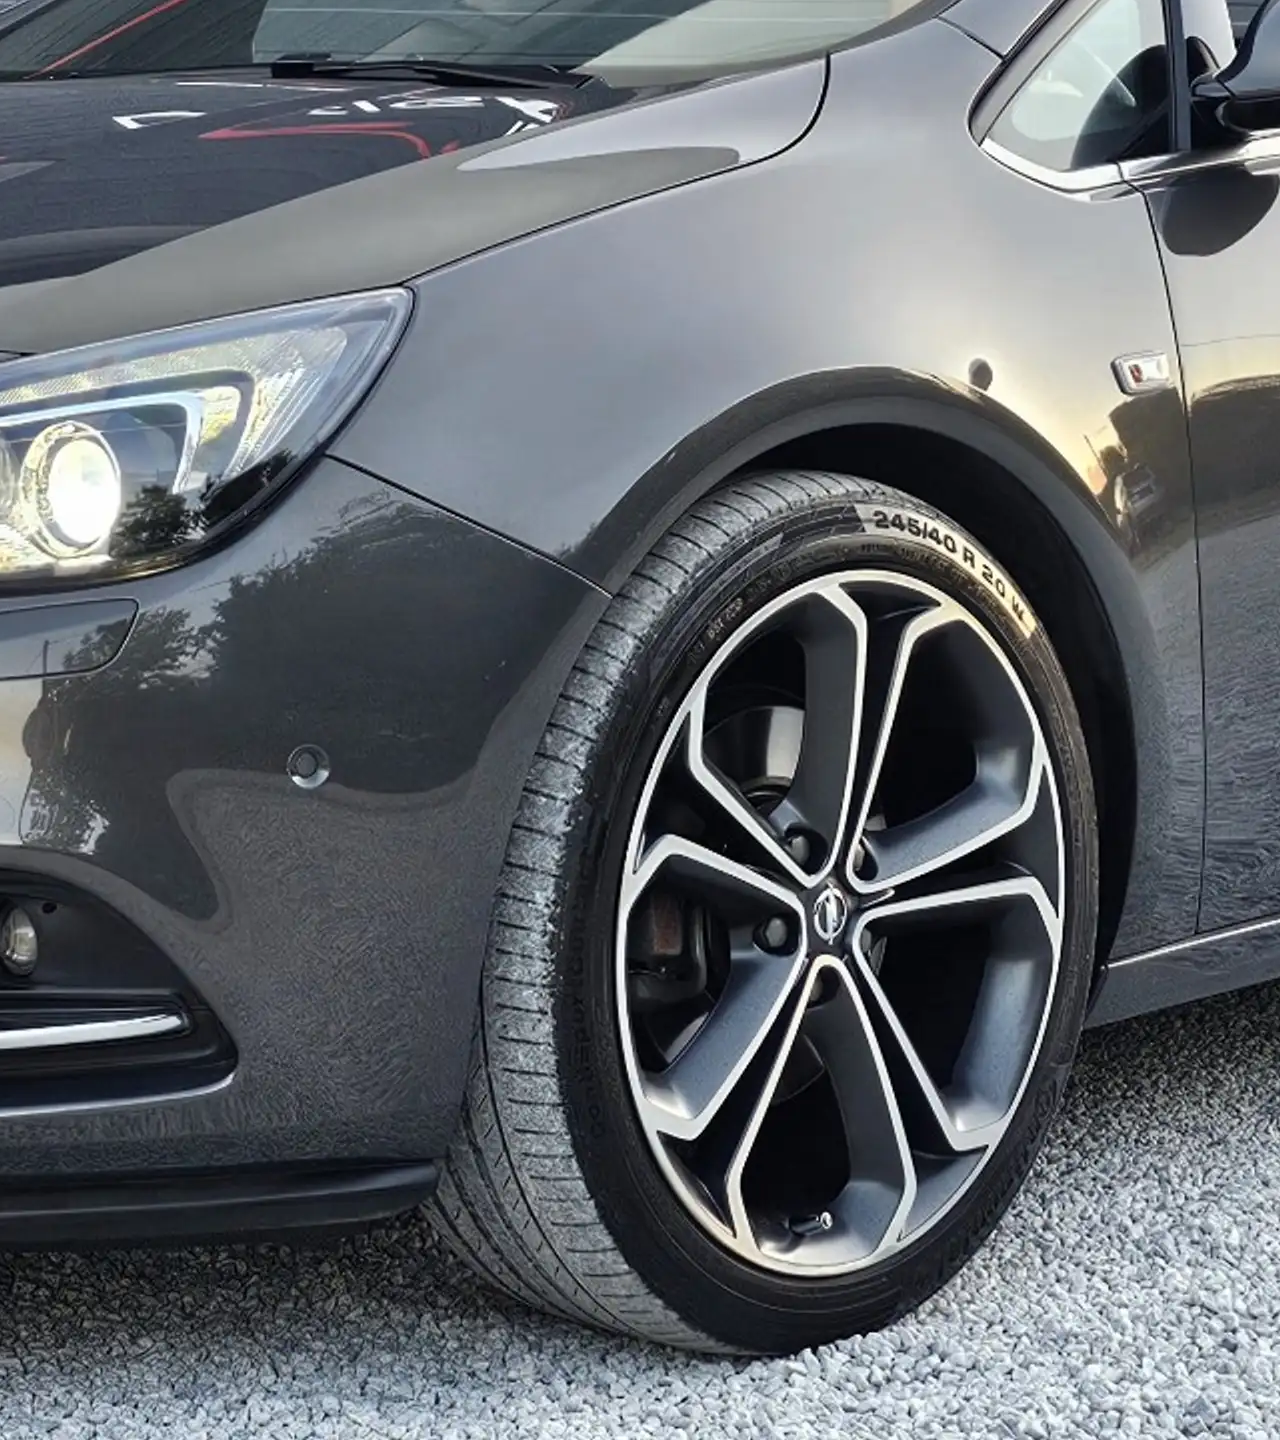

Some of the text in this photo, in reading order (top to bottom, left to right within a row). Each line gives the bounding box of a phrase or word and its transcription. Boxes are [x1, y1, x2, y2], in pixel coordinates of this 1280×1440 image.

[873, 510, 957, 554] 245/40
[963, 545, 977, 570] R
[981, 563, 1006, 598] 20
